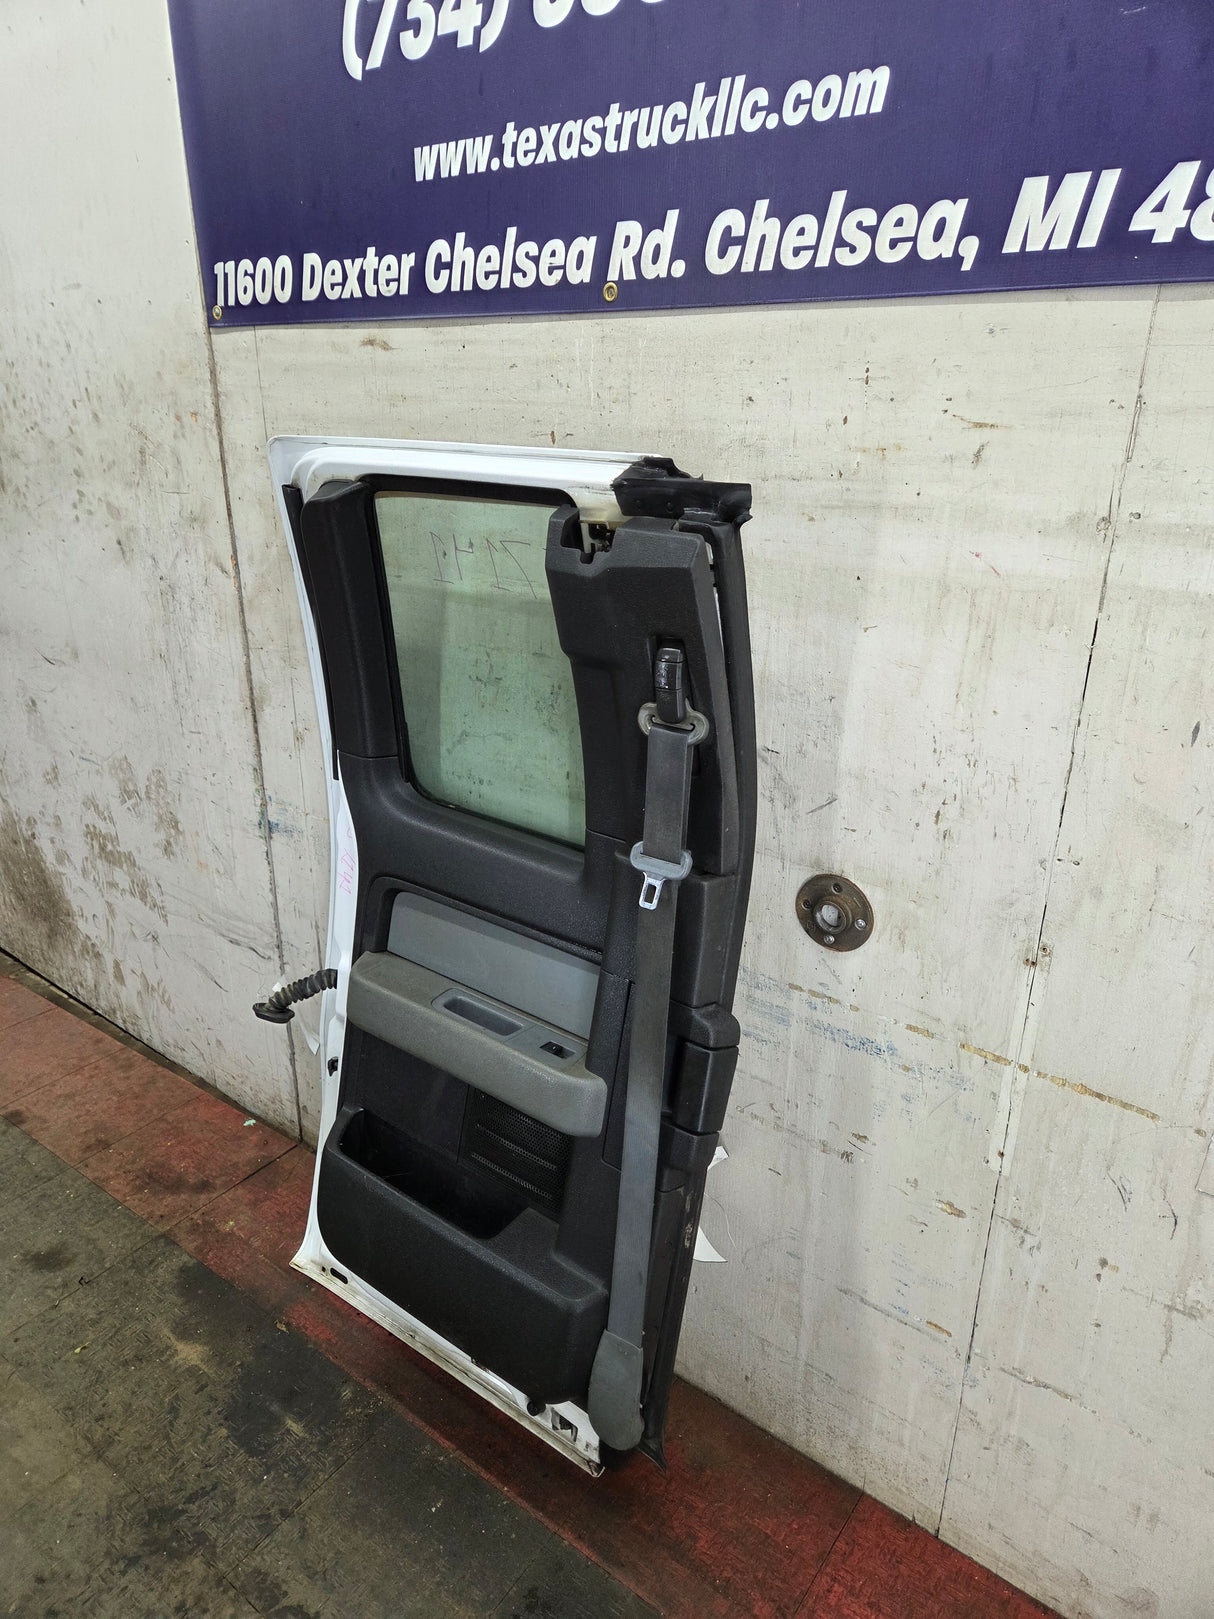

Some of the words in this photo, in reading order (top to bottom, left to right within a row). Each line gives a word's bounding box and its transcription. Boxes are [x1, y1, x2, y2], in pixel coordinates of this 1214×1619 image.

[413, 65, 891, 182] www.texastruckllc.com
[214, 253, 293, 307] 11600
[301, 246, 416, 302] Dexter
[424, 226, 598, 294] Chelsea
[606, 208, 687, 283] Rd.
[704, 189, 981, 276] Chelsea,
[1001, 167, 1123, 254] MI
